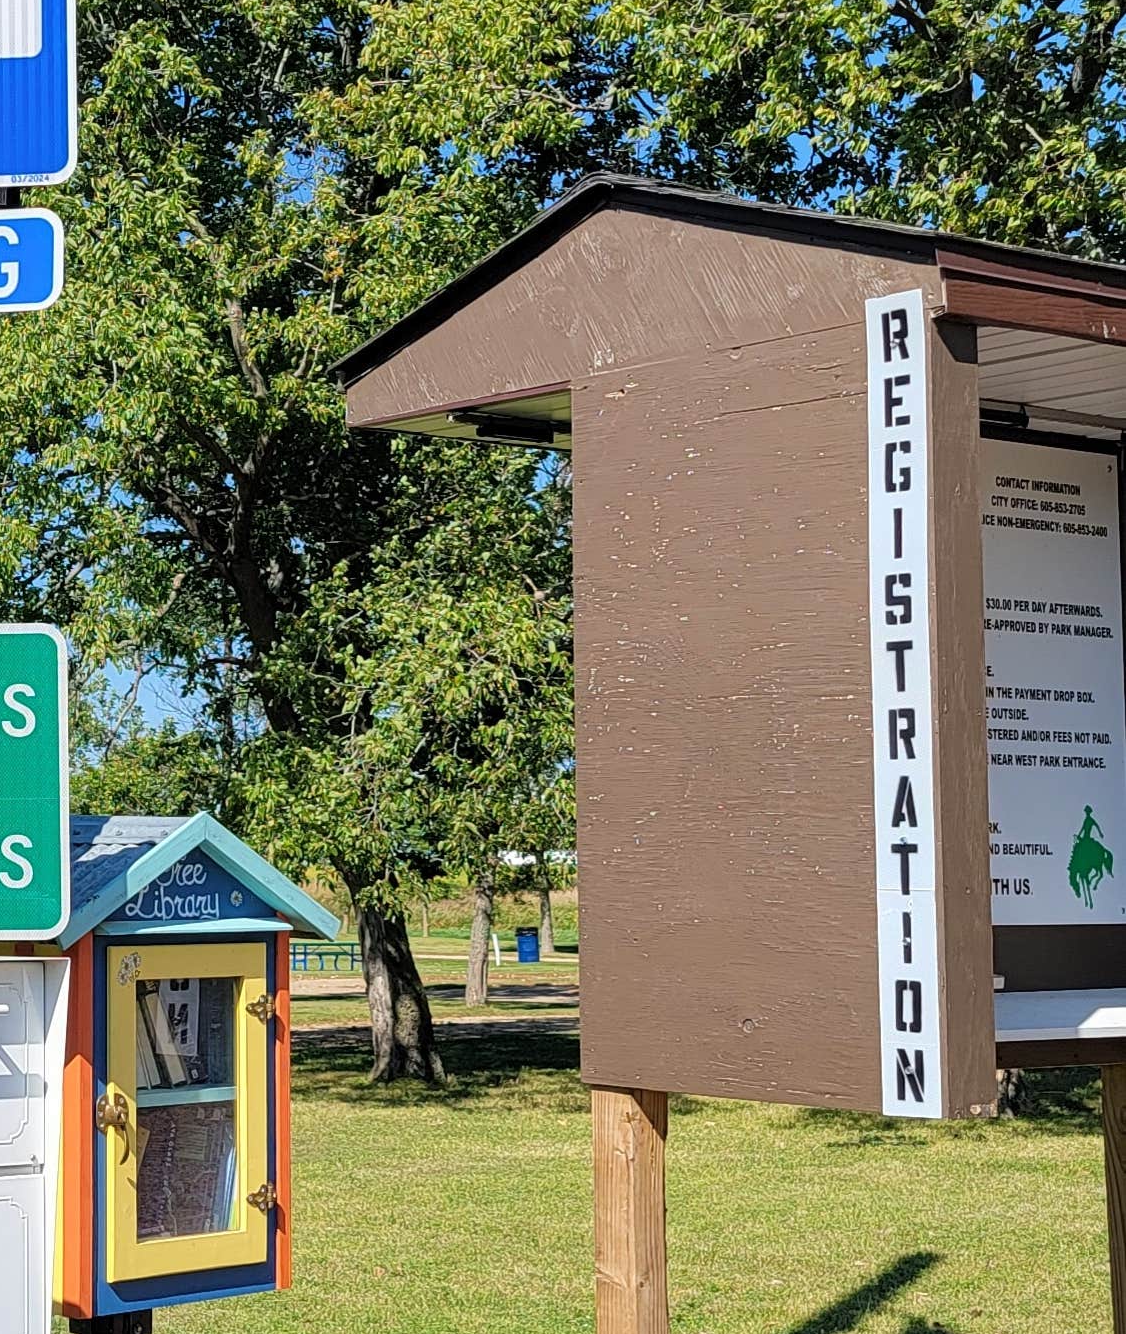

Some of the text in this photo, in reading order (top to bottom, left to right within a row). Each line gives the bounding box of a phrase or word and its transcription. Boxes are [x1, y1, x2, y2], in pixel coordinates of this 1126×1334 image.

[11, 174, 50, 183] 03/2024
[995, 476, 1080, 496] CONTACT INFORMATION
[991, 495, 1009, 507] CITY
[1010, 498, 1038, 511] OFFICE:
[981, 514, 995, 526] ICE
[997, 515, 1062, 533] NON-EMERGENCY:
[985, 597, 1103, 618] $30.00 PER DAY AFTERWARDS.
[1039, 622, 1049, 634] BY
[1051, 623, 1073, 636] PARK
[1074, 625, 1114, 638] MANAGER.
[997, 687, 1013, 699] THE
[1015, 688, 1052, 702] PAYMENT
[1054, 690, 1074, 702] DROP
[1077, 692, 1095, 703] BOX.
[881, 308, 925, 1103] REGISTRATION
[991, 708, 1029, 720] OUTSIDE.
[987, 728, 1019, 740] STERED
[1053, 731, 1072, 743] FEES
[1074, 732, 1091, 744] NOT
[1092, 733, 1112, 745] PAID.
[991, 754, 1013, 766] NEAR
[1015, 755, 1038, 767] WEST
[1039, 756, 1060, 767] PARK
[1062, 756, 1106, 769] ENTRANCE.
[988, 843, 1053, 855] ND BEAUTIFUL.
[990, 878, 1033, 896] TH US.
[125, 885, 220, 921] Library
